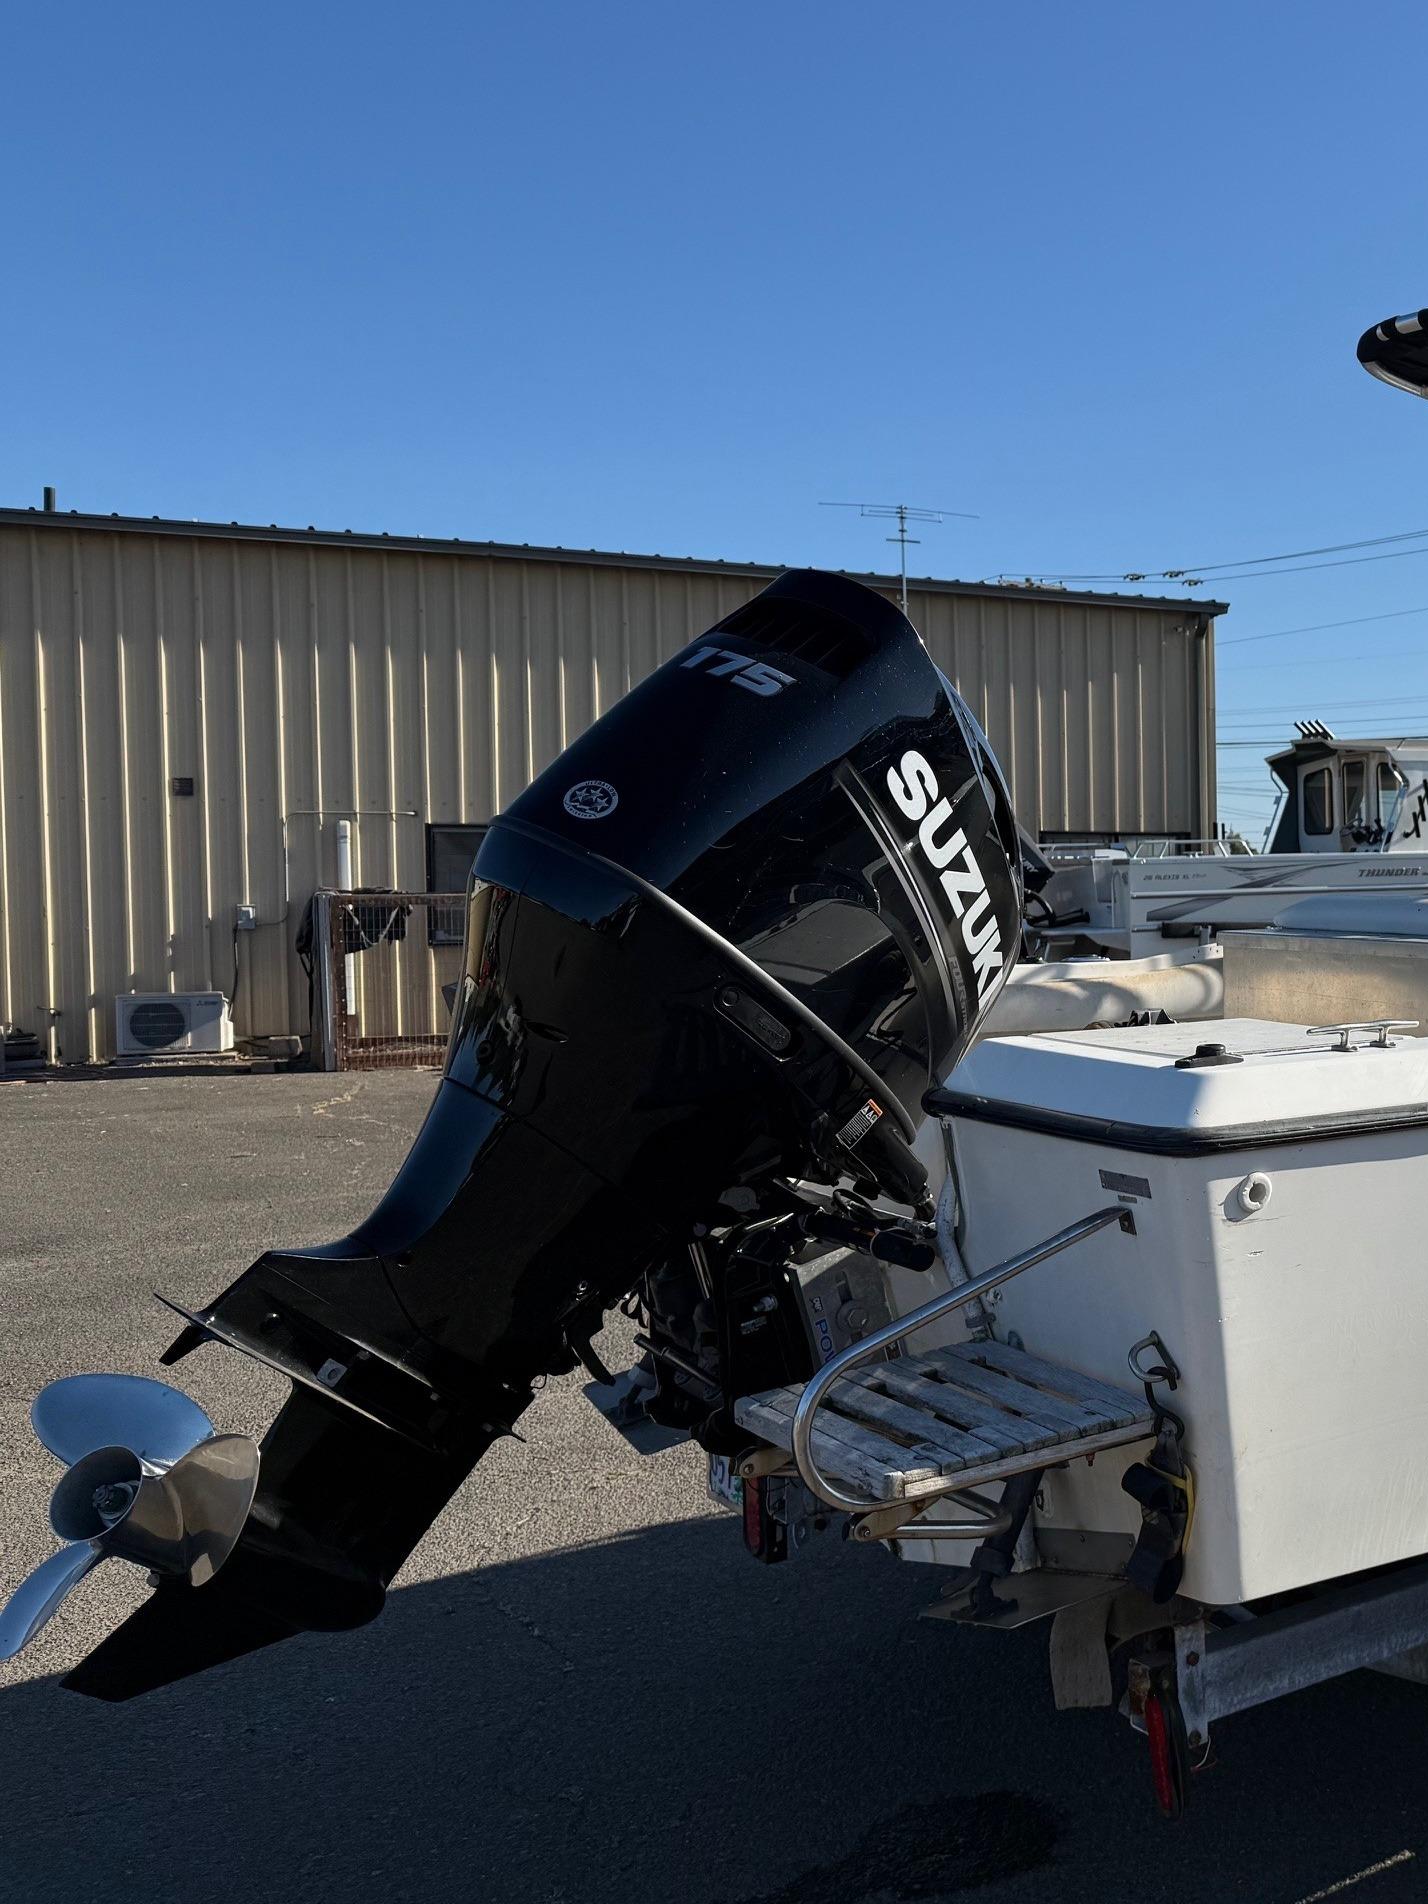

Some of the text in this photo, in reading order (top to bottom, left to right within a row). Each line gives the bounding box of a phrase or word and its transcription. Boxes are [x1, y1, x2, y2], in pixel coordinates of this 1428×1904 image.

[680, 646, 798, 697] 175
[887, 750, 1004, 1012] SUZUKI
[1358, 867, 1420, 877] THUNDER
